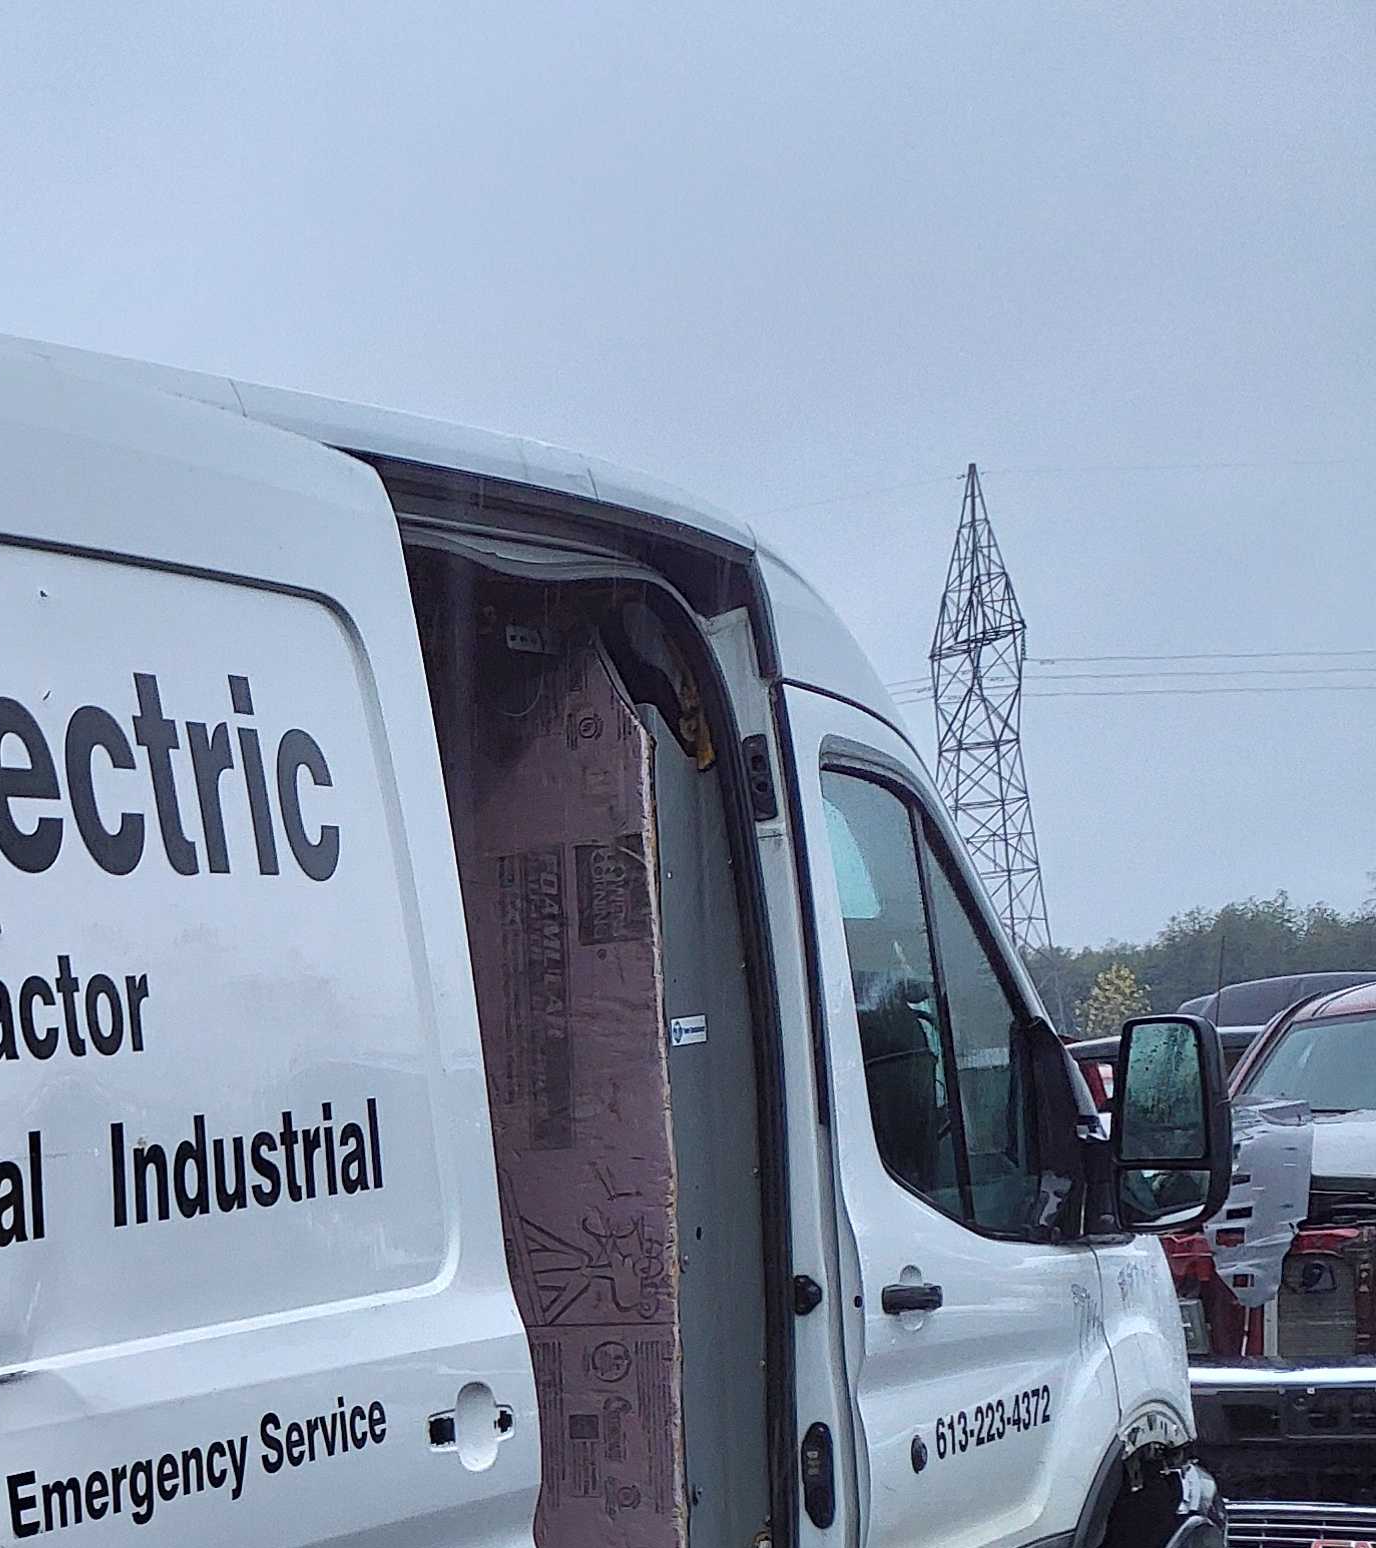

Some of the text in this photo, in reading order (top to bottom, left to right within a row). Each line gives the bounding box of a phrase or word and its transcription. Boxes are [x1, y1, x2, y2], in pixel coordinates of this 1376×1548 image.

[111, 1098, 384, 1228] Industrial
[8, 1434, 249, 1540] Emergency
[259, 1396, 388, 1475] Service
[935, 1385, 1051, 1460] 613-223-4372
